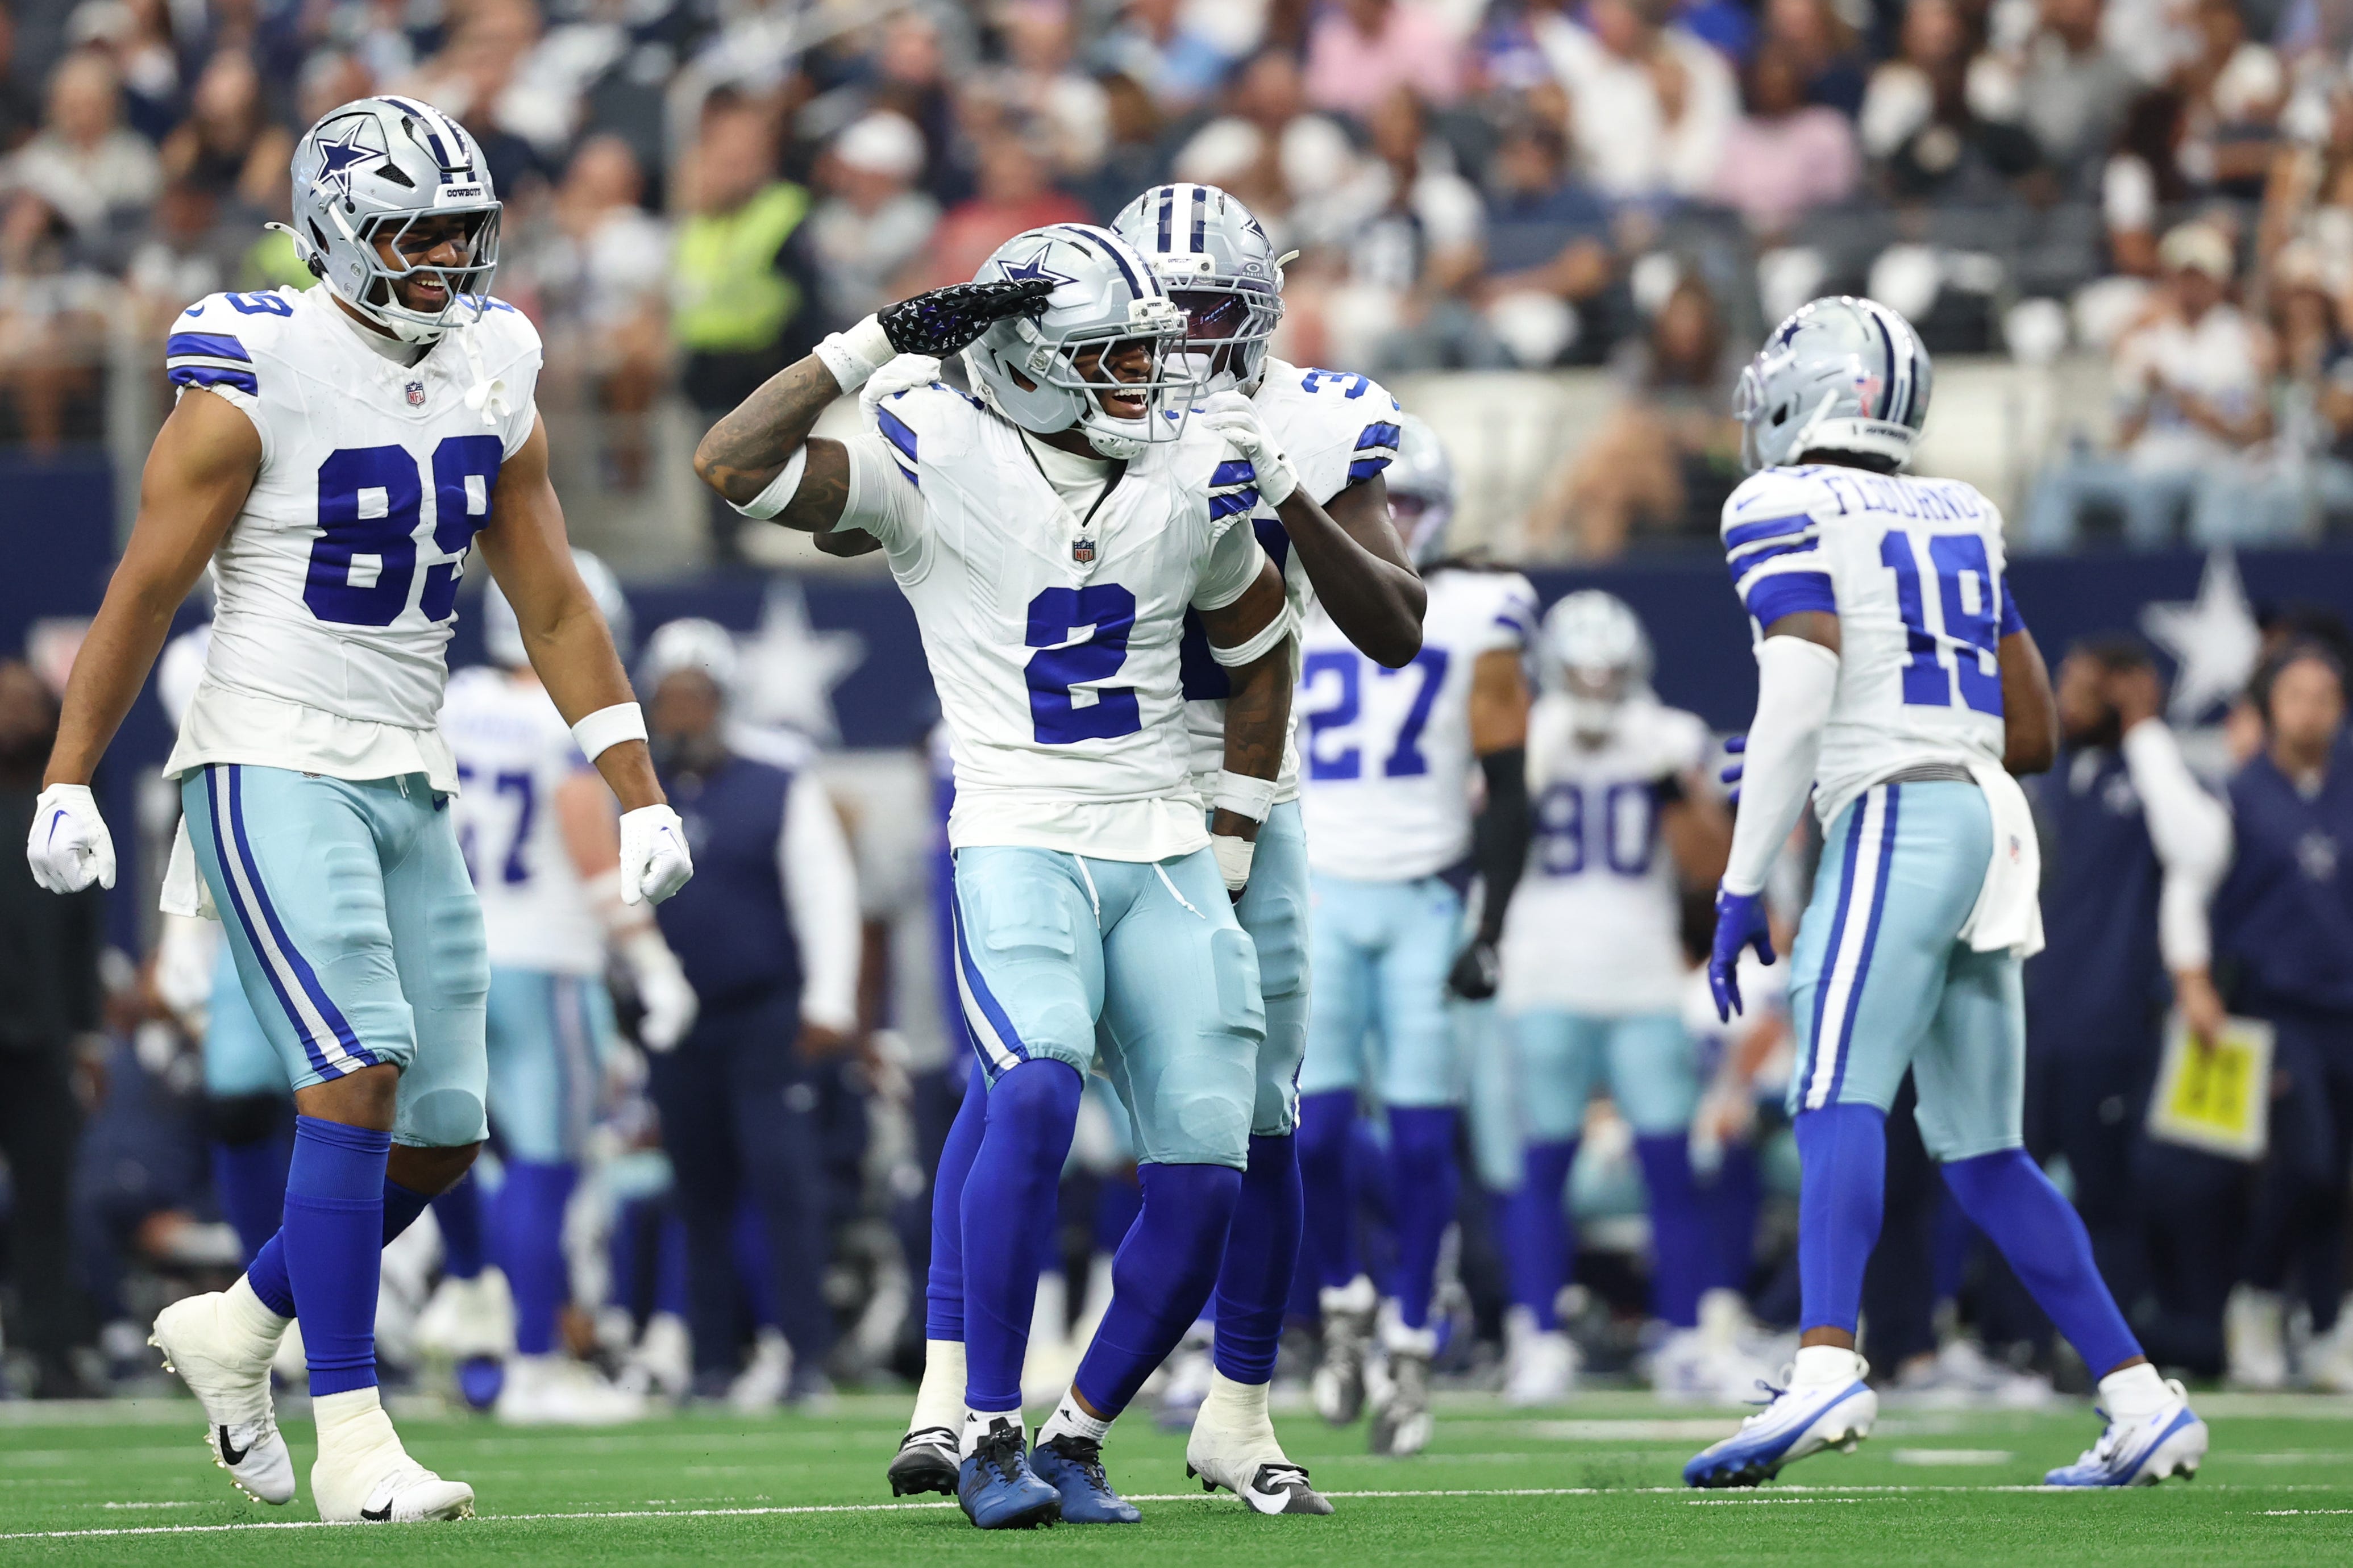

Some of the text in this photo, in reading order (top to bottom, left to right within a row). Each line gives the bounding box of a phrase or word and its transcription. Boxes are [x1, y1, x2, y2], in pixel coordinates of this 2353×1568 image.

[447, 188, 481, 197] COWBOYS
[409, 392, 424, 402] NFL
[304, 435, 504, 628] 89
[1822, 476, 1980, 520] FLOURNO
[1076, 550, 1092, 560] NFL
[1024, 583, 1142, 744] 2
[1880, 530, 2002, 718] 19
[1299, 644, 1450, 782] 27
[1536, 782, 1658, 879] 90
